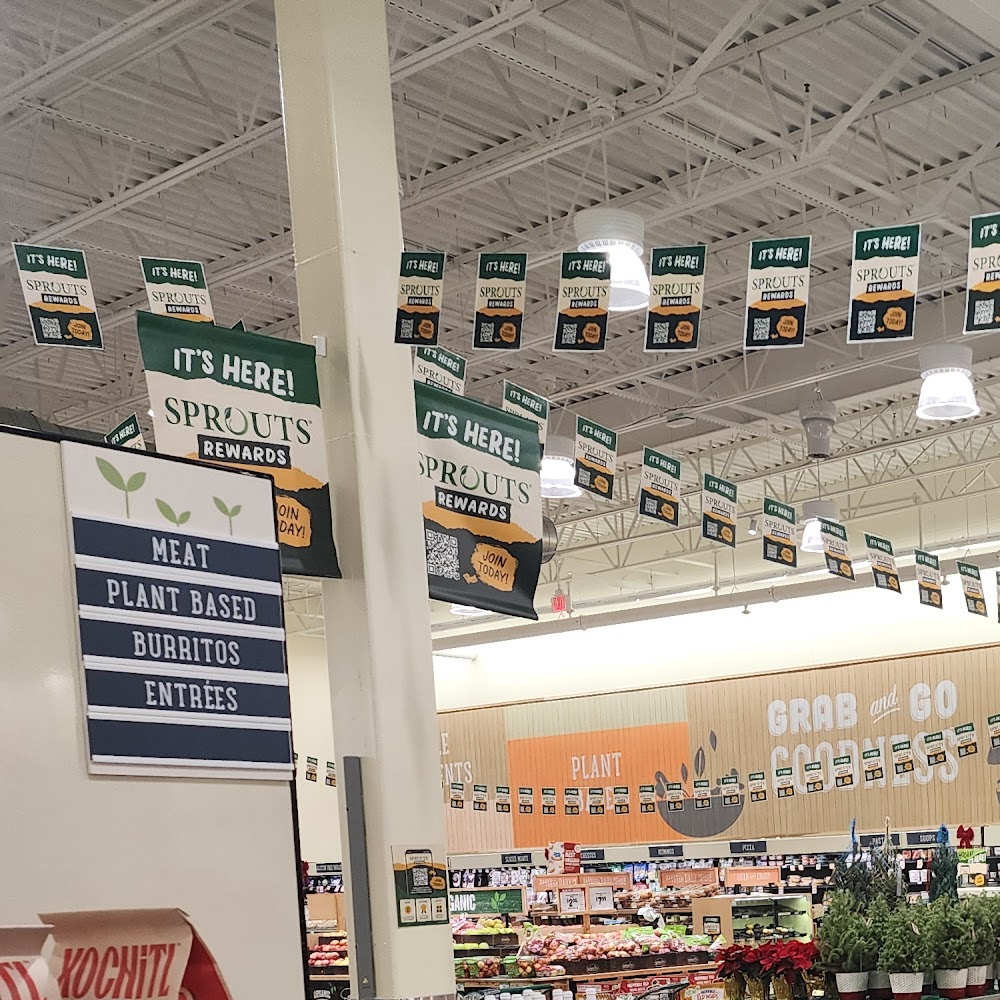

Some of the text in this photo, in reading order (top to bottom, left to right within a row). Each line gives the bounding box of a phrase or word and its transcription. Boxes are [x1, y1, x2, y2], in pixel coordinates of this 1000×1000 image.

[980, 225, 997, 239] IT'S
[863, 236, 910, 251] IT'S HERE!
[27, 254, 77, 271] IT'S HERE!
[658, 255, 699, 269] IT'S HERE!
[758, 247, 802, 261] IT'S HERE!
[152, 267, 197, 282] IT'S HERE!
[568, 260, 605, 273] IT'S HERE!
[856, 265, 913, 281] SPROUTS
[26, 280, 88, 295] SPROUTS
[653, 282, 700, 295] SPROUTS
[752, 275, 804, 290] SPROUTS
[152, 291, 206, 305] SPROUTS
[563, 286, 608, 298] SPROUTS
[174, 348, 295, 396] IT'S HERE!
[417, 364, 461, 391] SPROUTS
[165, 397, 311, 444] SPROUTS
[423, 411, 521, 463] IT'S HERE!
[203, 441, 286, 465] REWARDS
[578, 441, 613, 462] SPROUTS
[644, 471, 678, 491] SPROUTS
[276, 504, 299, 519] OIN
[439, 492, 507, 520] REWARDS
[279, 520, 305, 538] DAY!
[152, 536, 210, 568] MEAT
[483, 551, 507, 567] JOIN
[477, 563, 509, 584] TODAY!
[106, 579, 256, 622] PLANT BASED
[132, 630, 240, 666] BURRITOS
[144, 680, 238, 711] ENTRÉES
[767, 679, 958, 737] GRAB and GO
[571, 752, 622, 781] PLANT
[920, 834, 936, 842] SOUPS
